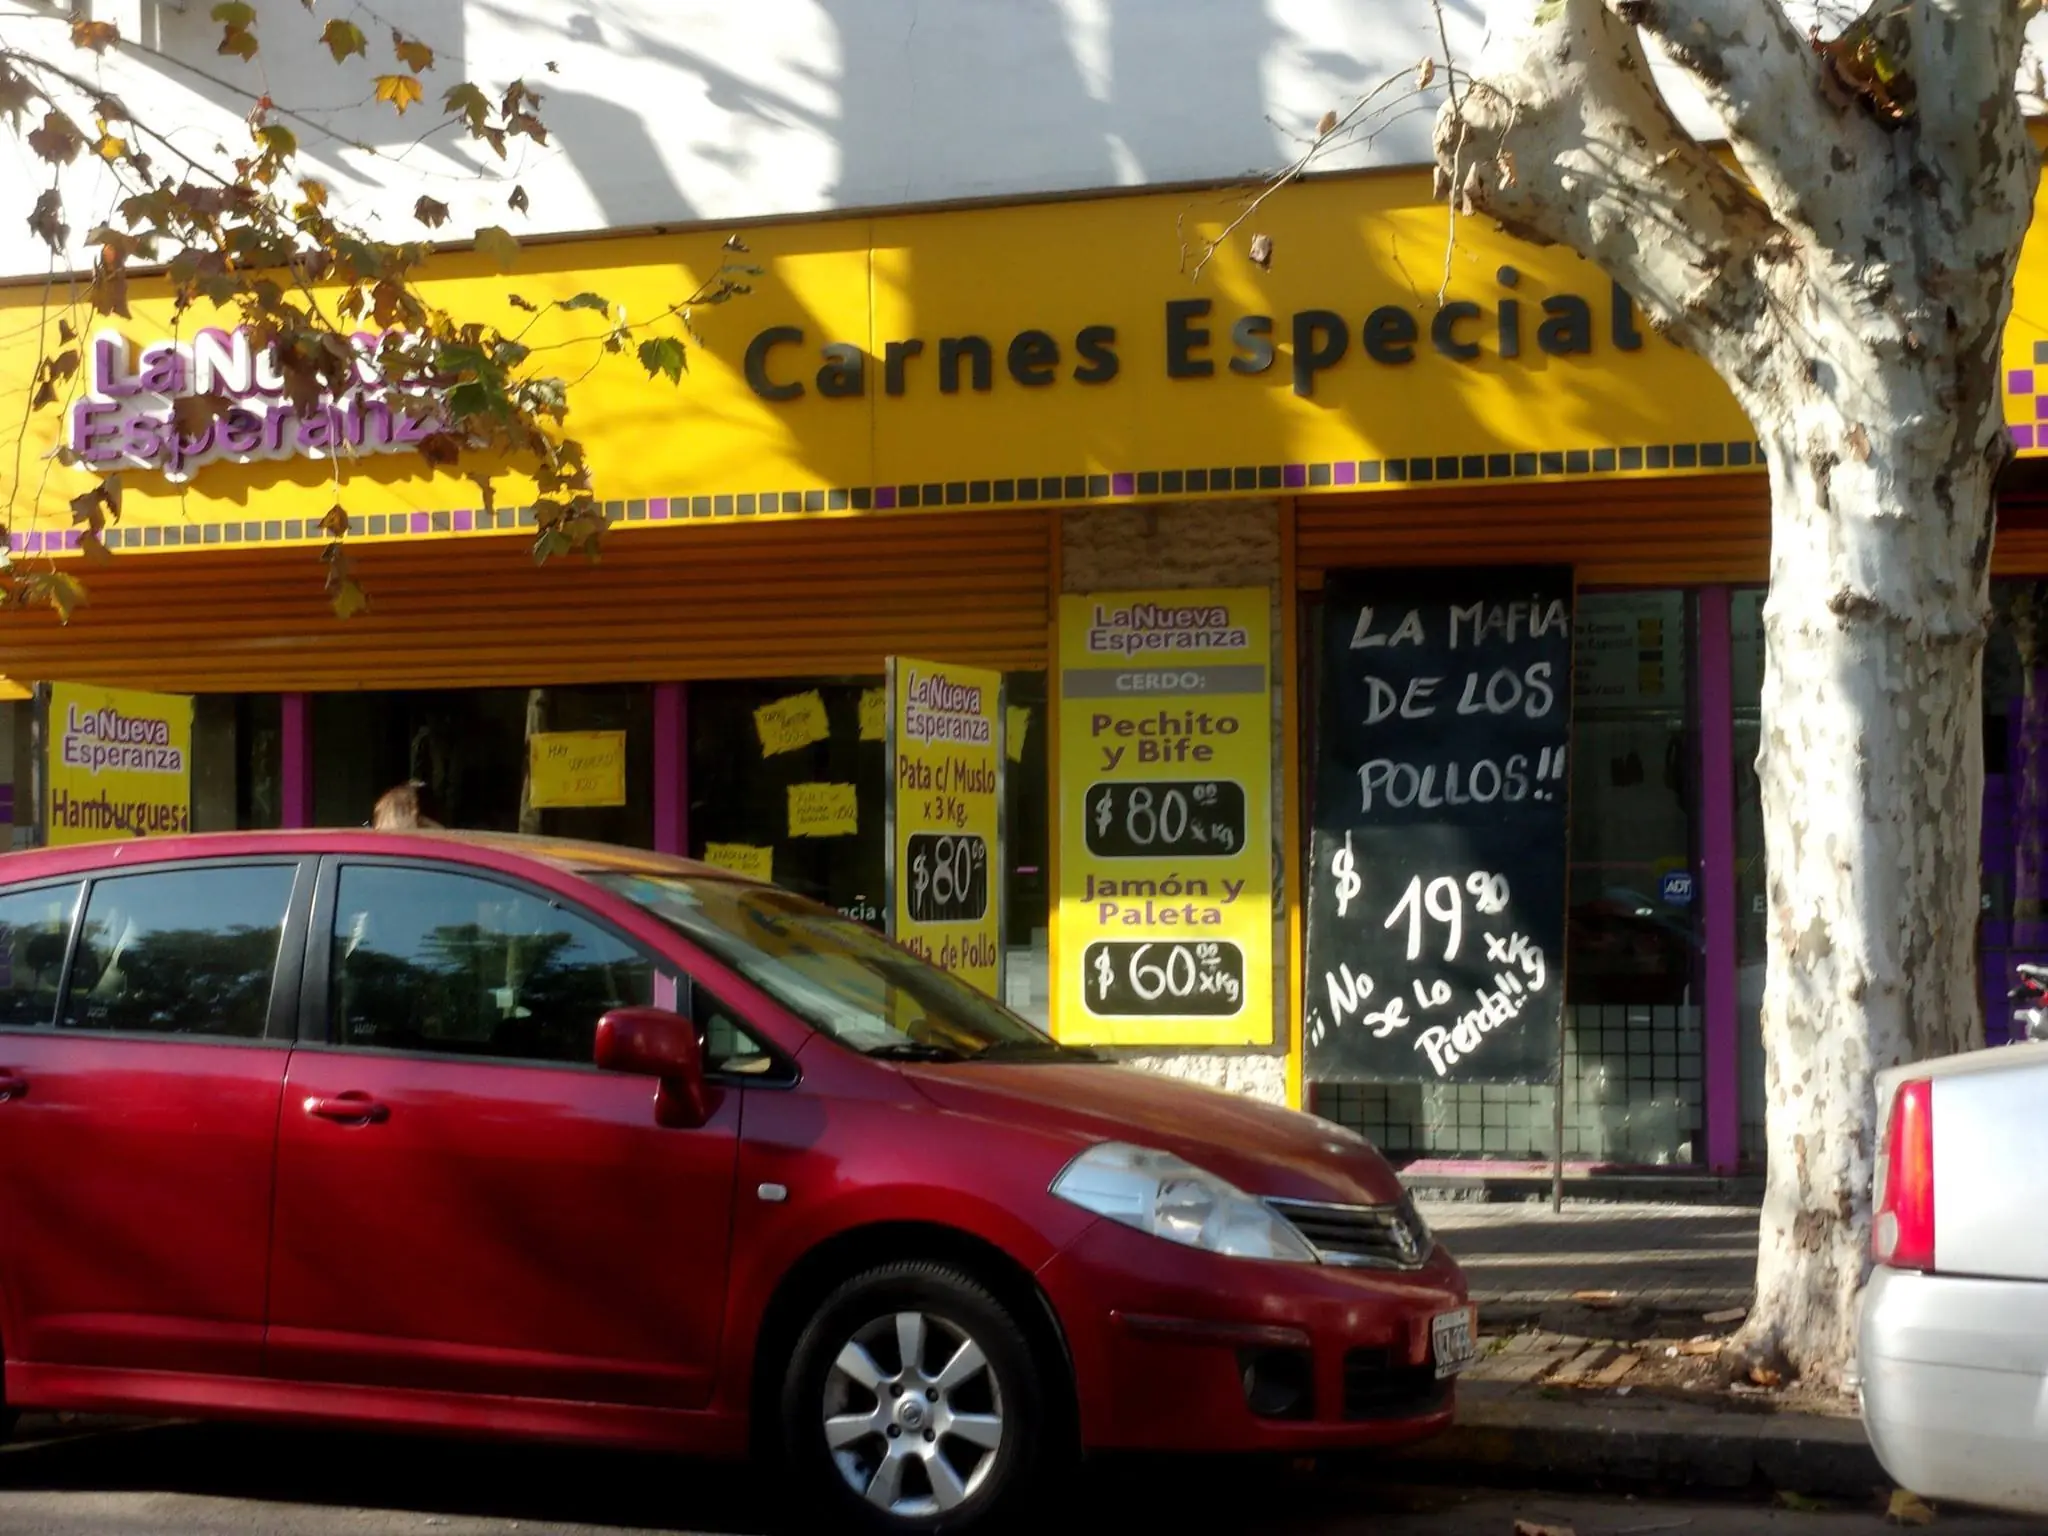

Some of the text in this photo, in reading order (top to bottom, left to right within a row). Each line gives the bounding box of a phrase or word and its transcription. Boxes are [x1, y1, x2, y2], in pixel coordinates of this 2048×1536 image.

[743, 324, 1119, 400] Carnes
[72, 400, 447, 473] Esperanz
[1090, 629, 1246, 654] Esperanza
[1350, 604, 1425, 649] LA
[1115, 672, 1206, 690] CERDO:
[1362, 661, 1554, 725] DE LOS
[905, 705, 990, 743] Esperanza
[1092, 709, 1240, 737] Pechito
[64, 735, 182, 771] Esperanza
[1100, 738, 1214, 771] y Bife
[899, 754, 995, 794] Pata c/ Muslo
[1357, 745, 1566, 813] POLLOS!!
[923, 801, 931, 820] x
[935, 796, 944, 821] 3
[1126, 786, 1188, 845] 80
[1083, 872, 1246, 904] Jamón y
[1664, 879, 1692, 894] ADT
[1099, 900, 1222, 926] Paleta
[1383, 873, 1462, 961] 19
[940, 933, 958, 970] de
[961, 932, 997, 968] Pollo
[1128, 942, 1197, 1001] 60
[1362, 996, 1411, 1038] se
